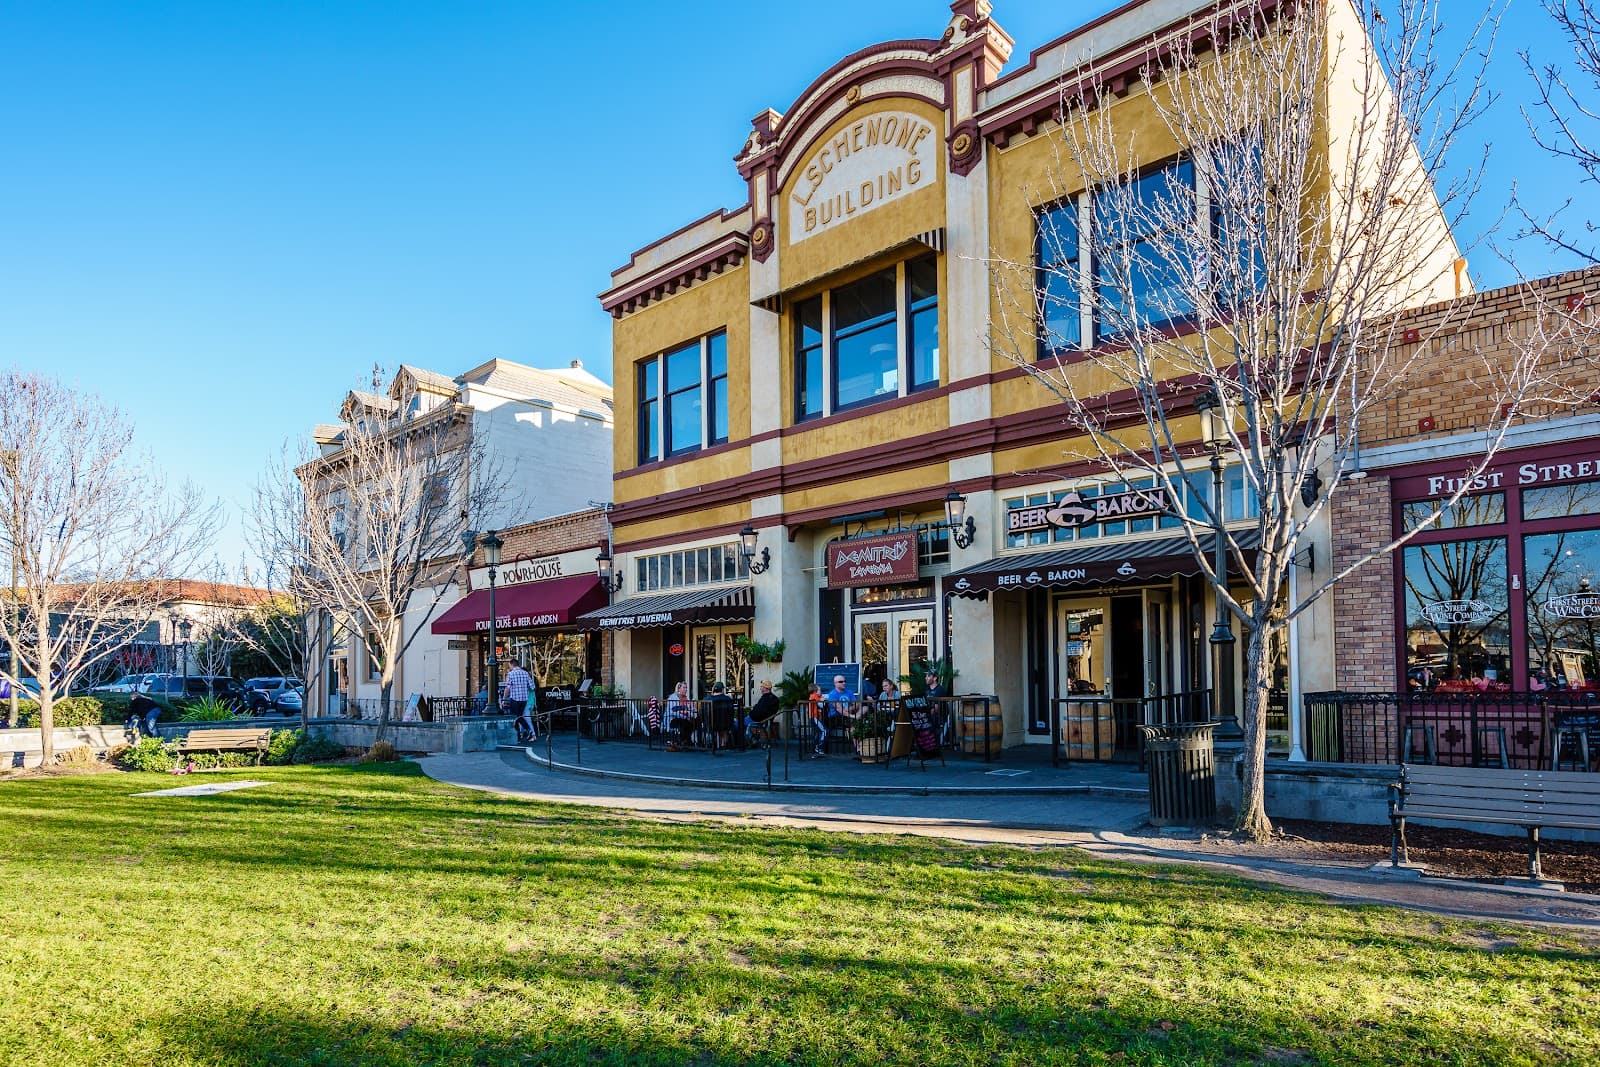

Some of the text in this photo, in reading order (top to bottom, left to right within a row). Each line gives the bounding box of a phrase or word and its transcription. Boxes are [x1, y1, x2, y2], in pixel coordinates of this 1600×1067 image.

[806, 115, 931, 187] SCHENONE
[804, 158, 921, 232] BUILDING
[1010, 490, 1164, 529] BEER BARON
[503, 561, 562, 584] POURHOUSE
[849, 562, 893, 578] TAVERNA
[998, 569, 1086, 585] BEER BARON
[1445, 602, 1468, 612] STREET
[1571, 595, 1598, 606] STREET
[637, 612, 672, 624] TAVERNA
[1430, 612, 1453, 624] WINE
[1554, 606, 1581, 617] WINE
[475, 618, 512, 631] POUROUSE
[517, 616, 531, 627] BEER
[532, 613, 559, 625] GARDEN
